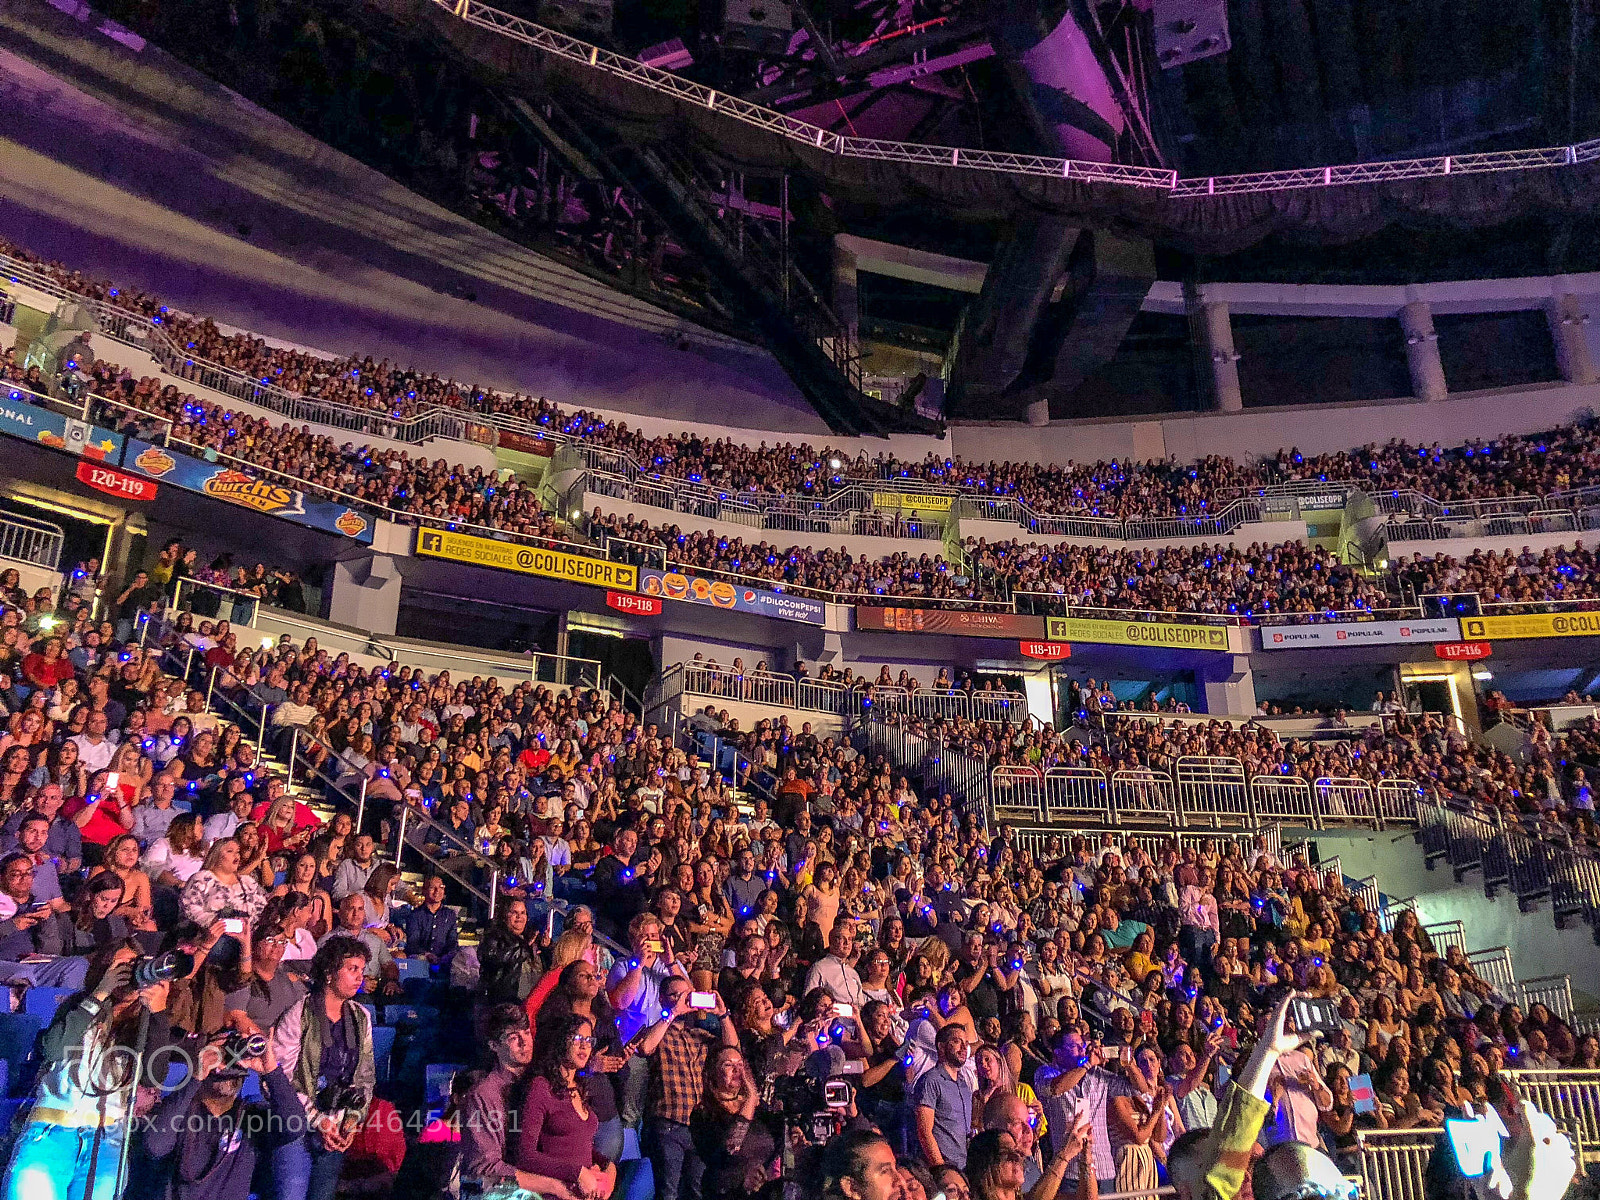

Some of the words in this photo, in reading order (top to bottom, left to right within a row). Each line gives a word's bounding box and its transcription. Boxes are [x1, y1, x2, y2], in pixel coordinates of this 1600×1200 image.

[91, 469, 144, 495] 120-119
[204, 479, 292, 503] Church's
[905, 494, 948, 506] @COLISEOPR
[445, 544, 472, 558] REDES
[474, 549, 513, 565] SOCIALES
[516, 549, 613, 582] @COLISEOPR
[617, 596, 653, 611] 119-118
[1126, 624, 1207, 644] @COLISEOPR
[1029, 644, 1061, 655] 118-117
[1445, 645, 1482, 656] 117-116
